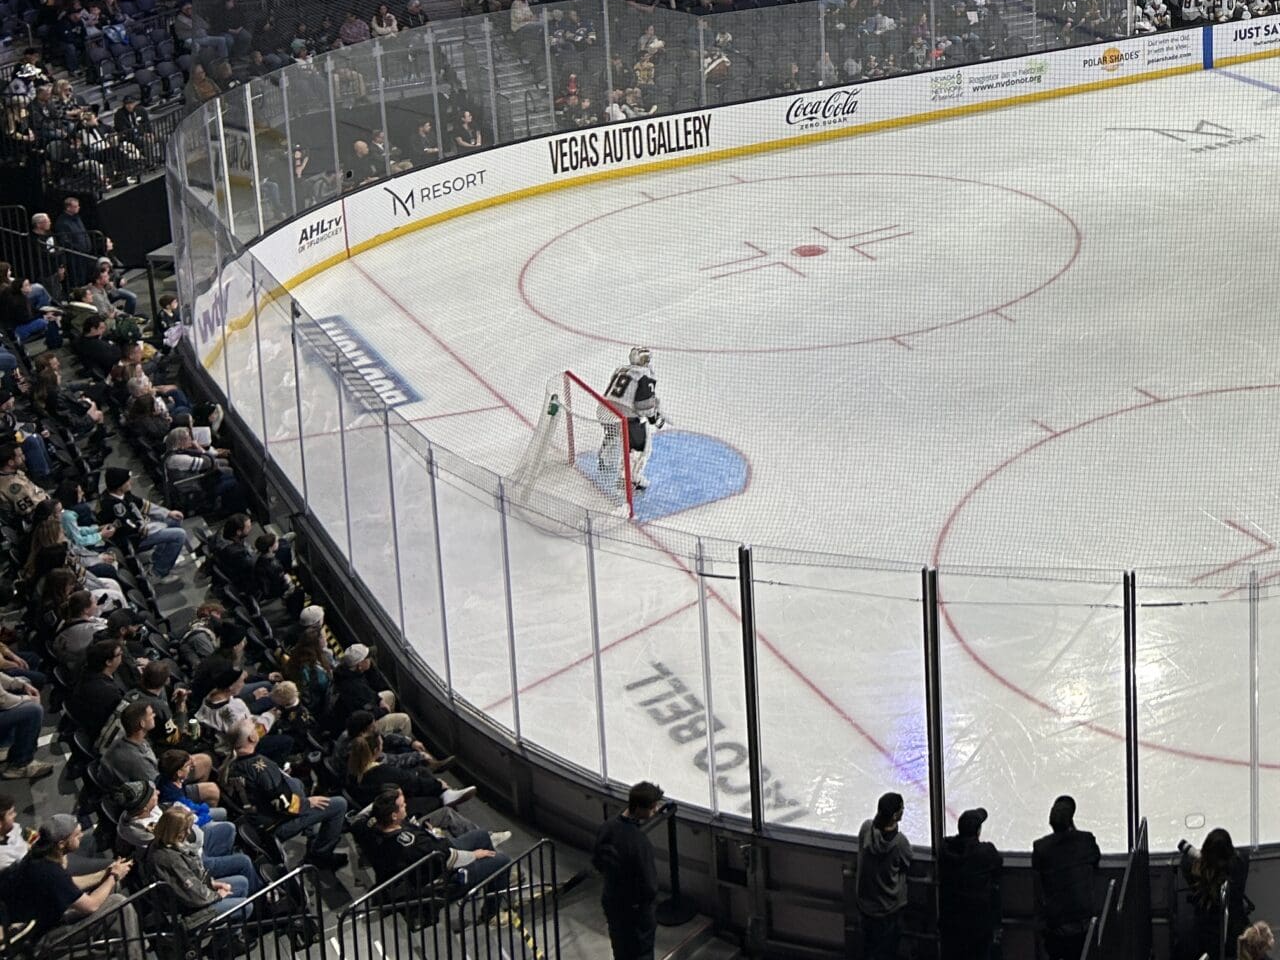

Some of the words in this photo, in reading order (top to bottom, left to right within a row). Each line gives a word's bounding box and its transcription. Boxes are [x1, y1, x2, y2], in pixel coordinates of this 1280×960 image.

[1233, 26, 1261, 41] JUST
[1083, 53, 1108, 68] POLAR
[1109, 50, 1139, 64] SHADES
[972, 75, 1042, 93] www.nvdonor.org
[786, 88, 862, 125] Coca-Cola
[549, 133, 599, 174] VEGAS
[603, 123, 643, 164] AUTO
[647, 114, 712, 156] GALLERY
[421, 170, 487, 202] RESORT
[624, 661, 727, 744] BELL
